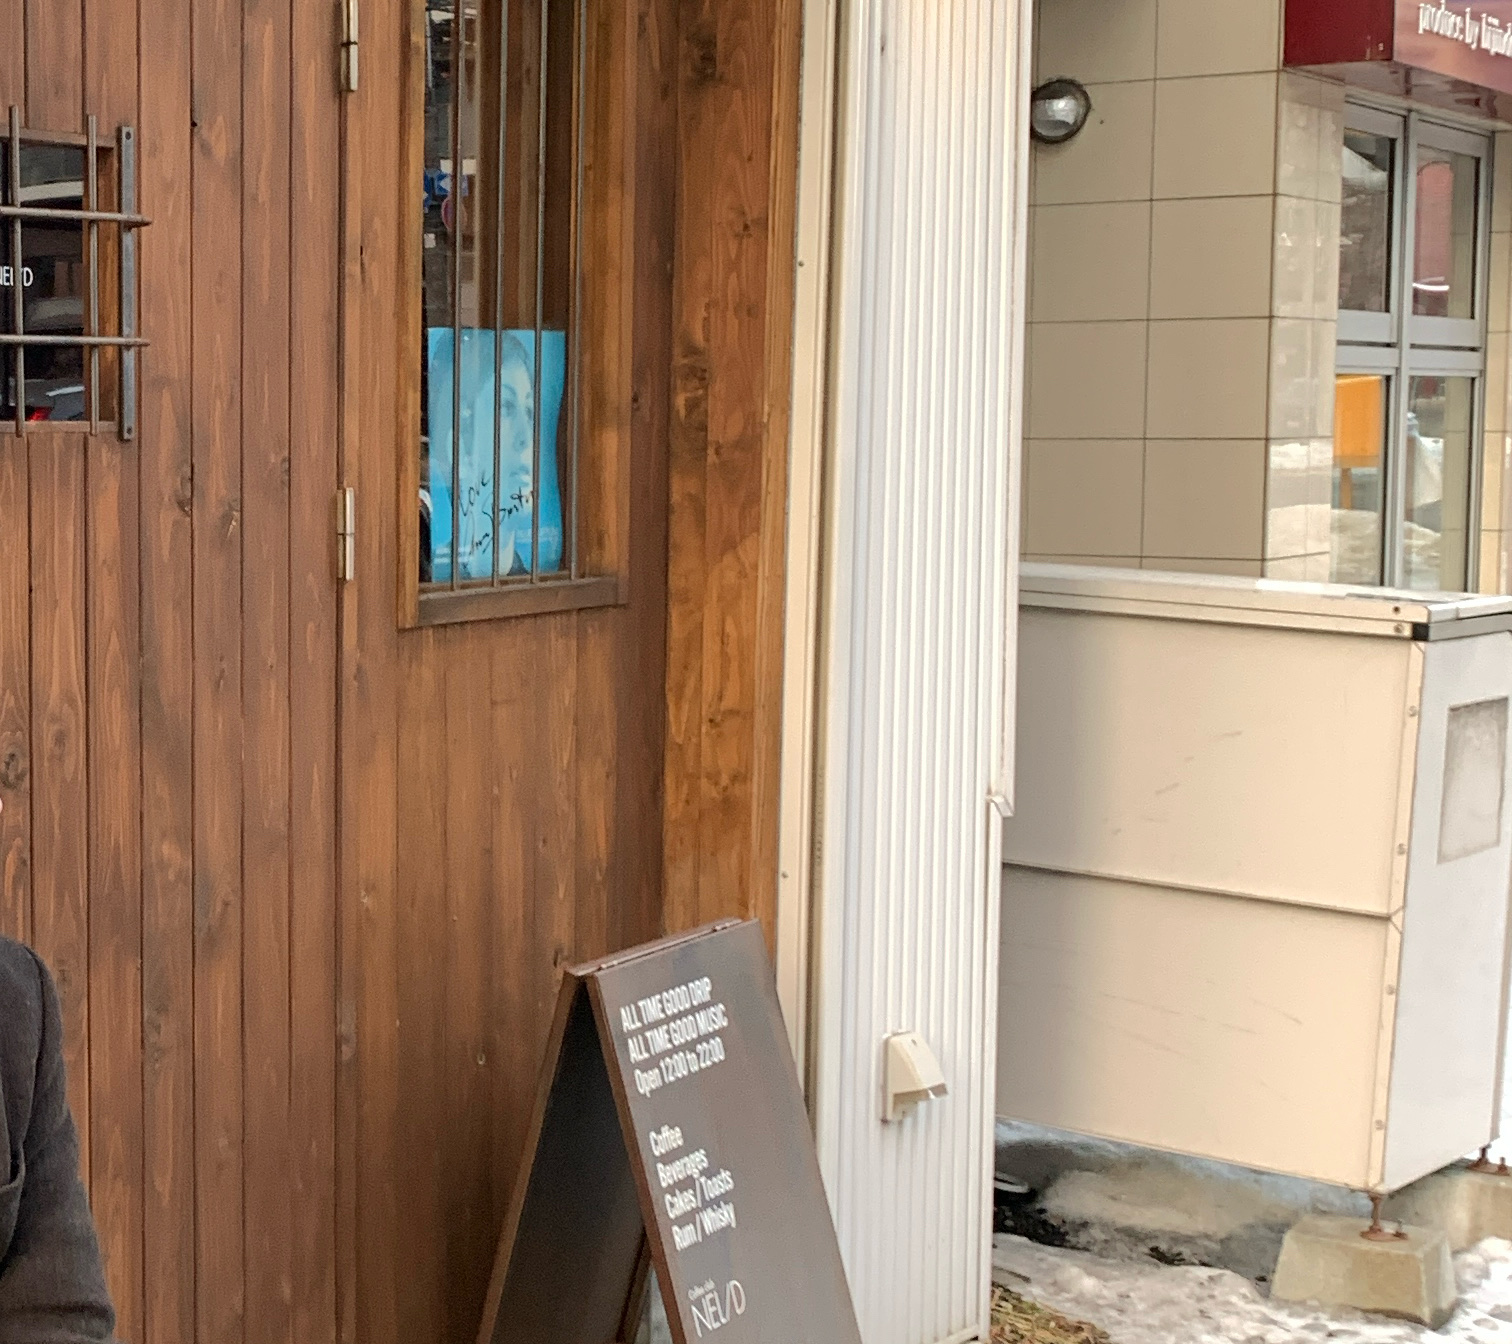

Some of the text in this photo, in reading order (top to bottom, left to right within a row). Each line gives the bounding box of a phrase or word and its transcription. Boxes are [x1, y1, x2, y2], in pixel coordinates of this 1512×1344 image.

[1465, 7, 1480, 50] by
[620, 976, 712, 1033] ALL TIME GOOD DRIP
[628, 1002, 729, 1064] ALL TIME GOOD MUSIC
[633, 1036, 726, 1098] Open 12:00 to 22:00
[649, 1124, 684, 1157] Coffee
[656, 1148, 709, 1188] Beverages
